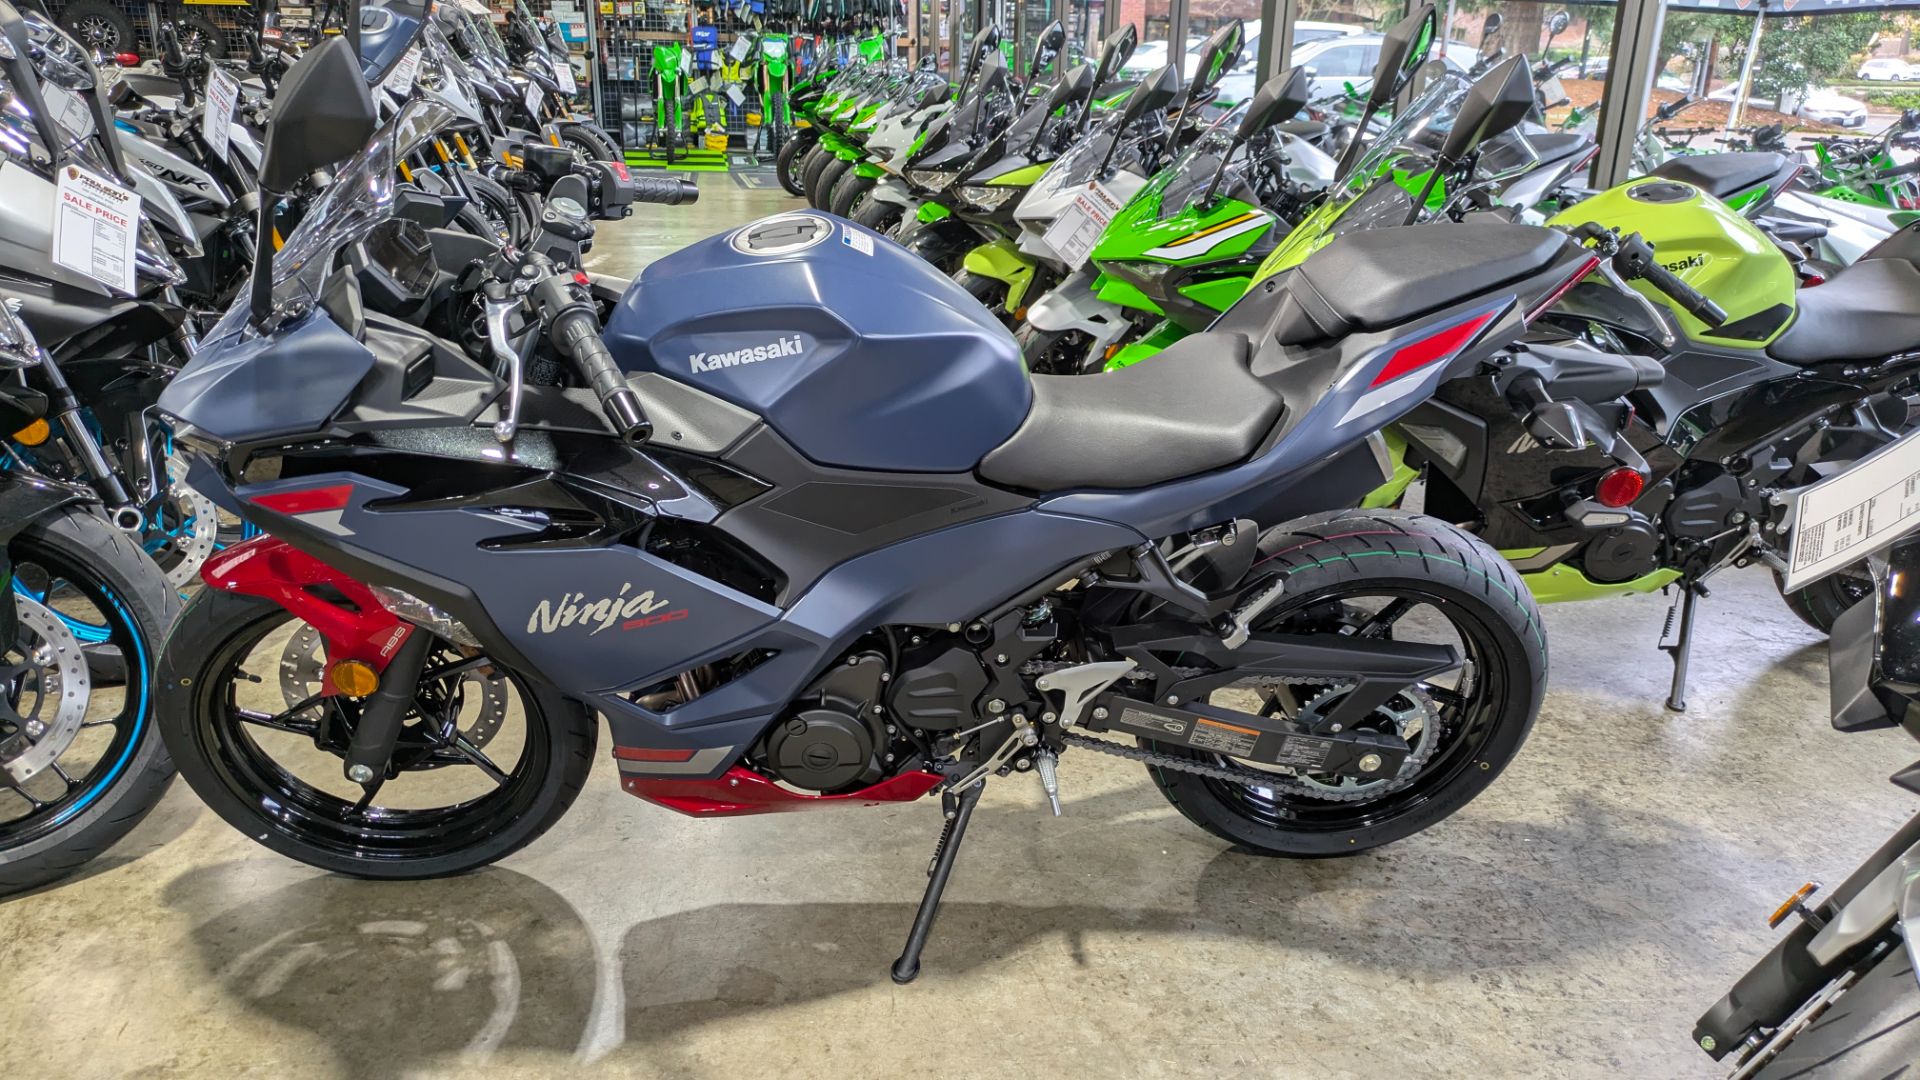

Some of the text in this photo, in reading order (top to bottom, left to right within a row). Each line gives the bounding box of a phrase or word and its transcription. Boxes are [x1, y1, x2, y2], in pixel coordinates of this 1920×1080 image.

[157, 168, 209, 192] NK
[63, 191, 93, 212] SALE
[95, 206, 129, 229] PRICE
[1076, 196, 1091, 213] SALE
[1090, 208, 1108, 226] PRICE
[688, 334, 804, 375] Kawasaki
[526, 582, 690, 637] Ninja 500
[380, 626, 406, 657] ABS
